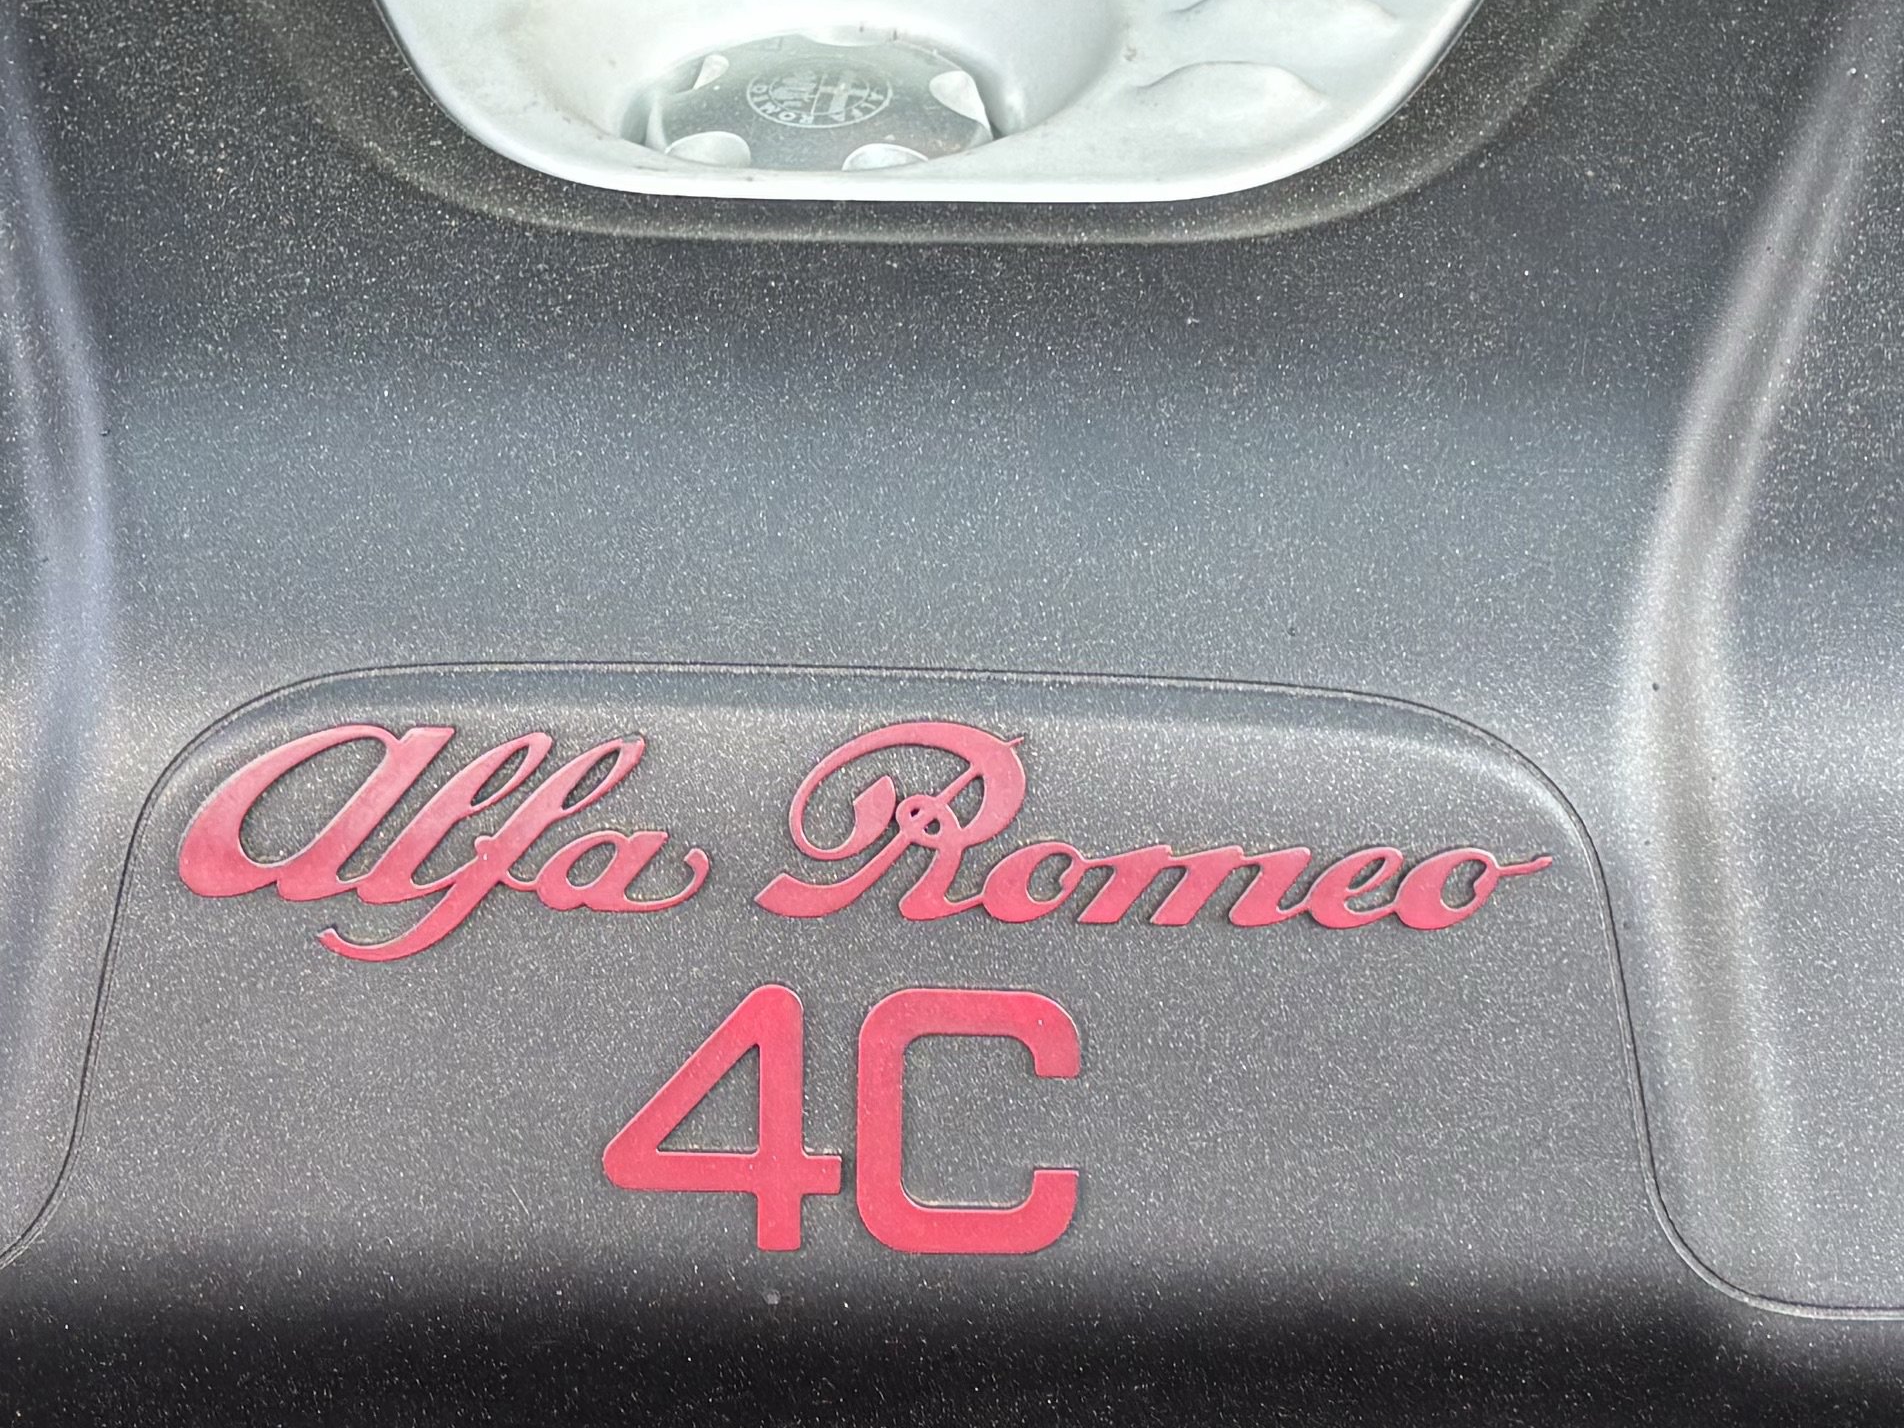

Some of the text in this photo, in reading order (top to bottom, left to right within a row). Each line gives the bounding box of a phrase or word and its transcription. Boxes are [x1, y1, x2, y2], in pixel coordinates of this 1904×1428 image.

[178, 721, 1554, 963] Alfa Romeo
[601, 983, 1082, 1257] 4C
